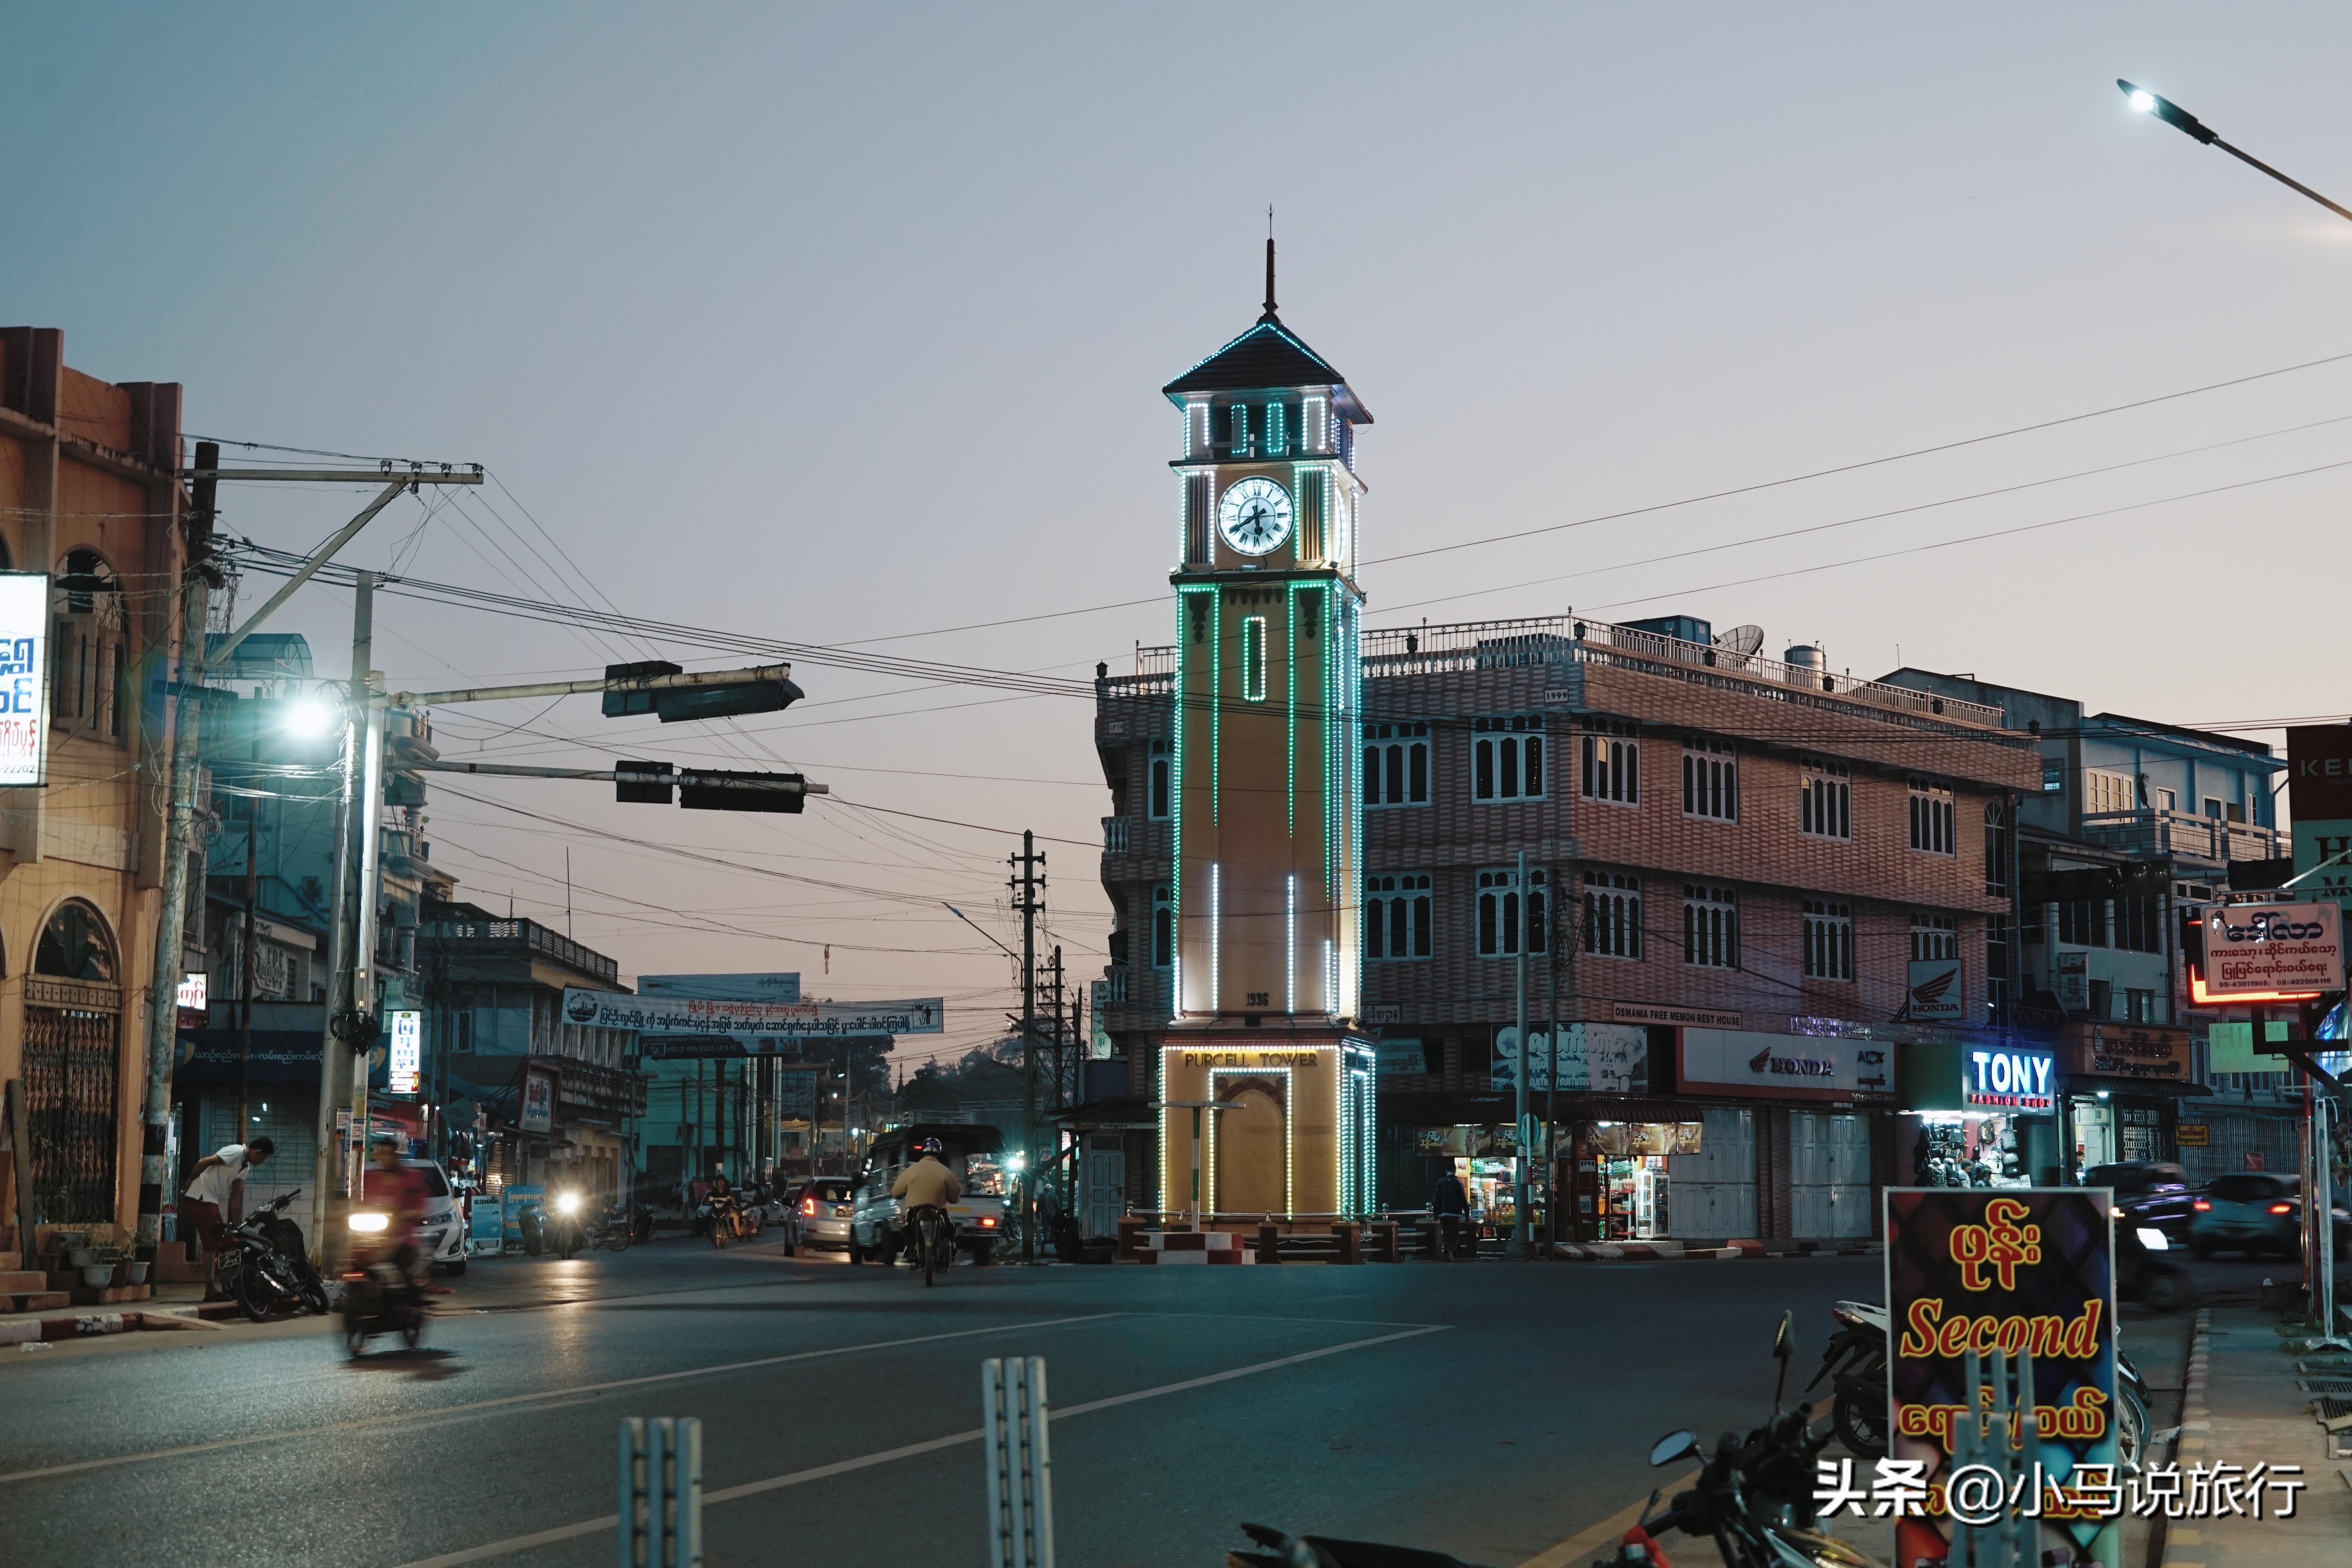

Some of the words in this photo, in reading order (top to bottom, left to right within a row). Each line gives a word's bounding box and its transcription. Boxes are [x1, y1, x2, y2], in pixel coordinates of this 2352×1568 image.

[1253, 485, 1261, 496] XII
[2300, 759, 2352, 777] KE
[1245, 992, 1269, 1007] 1936
[1912, 1004, 1959, 1013] HONDA
[1615, 1007, 1648, 1018] OSMANIA
[1650, 1010, 1668, 1020] FREE
[1670, 1012, 1695, 1022] MEMON
[1697, 1013, 1715, 1024] REST
[1717, 1016, 1740, 1026] HOUSE
[1185, 1053, 1250, 1067] PURCELL
[1259, 1053, 1317, 1066] TOWER
[1770, 1057, 1835, 1076] HONDA
[1972, 1051, 2052, 1094] TONY
[1970, 1094, 2018, 1107] FASHION
[2021, 1097, 2051, 1108] SHOP
[1949, 1198, 2042, 1292] ဖုန်း
[1899, 1298, 2103, 1359] Second
